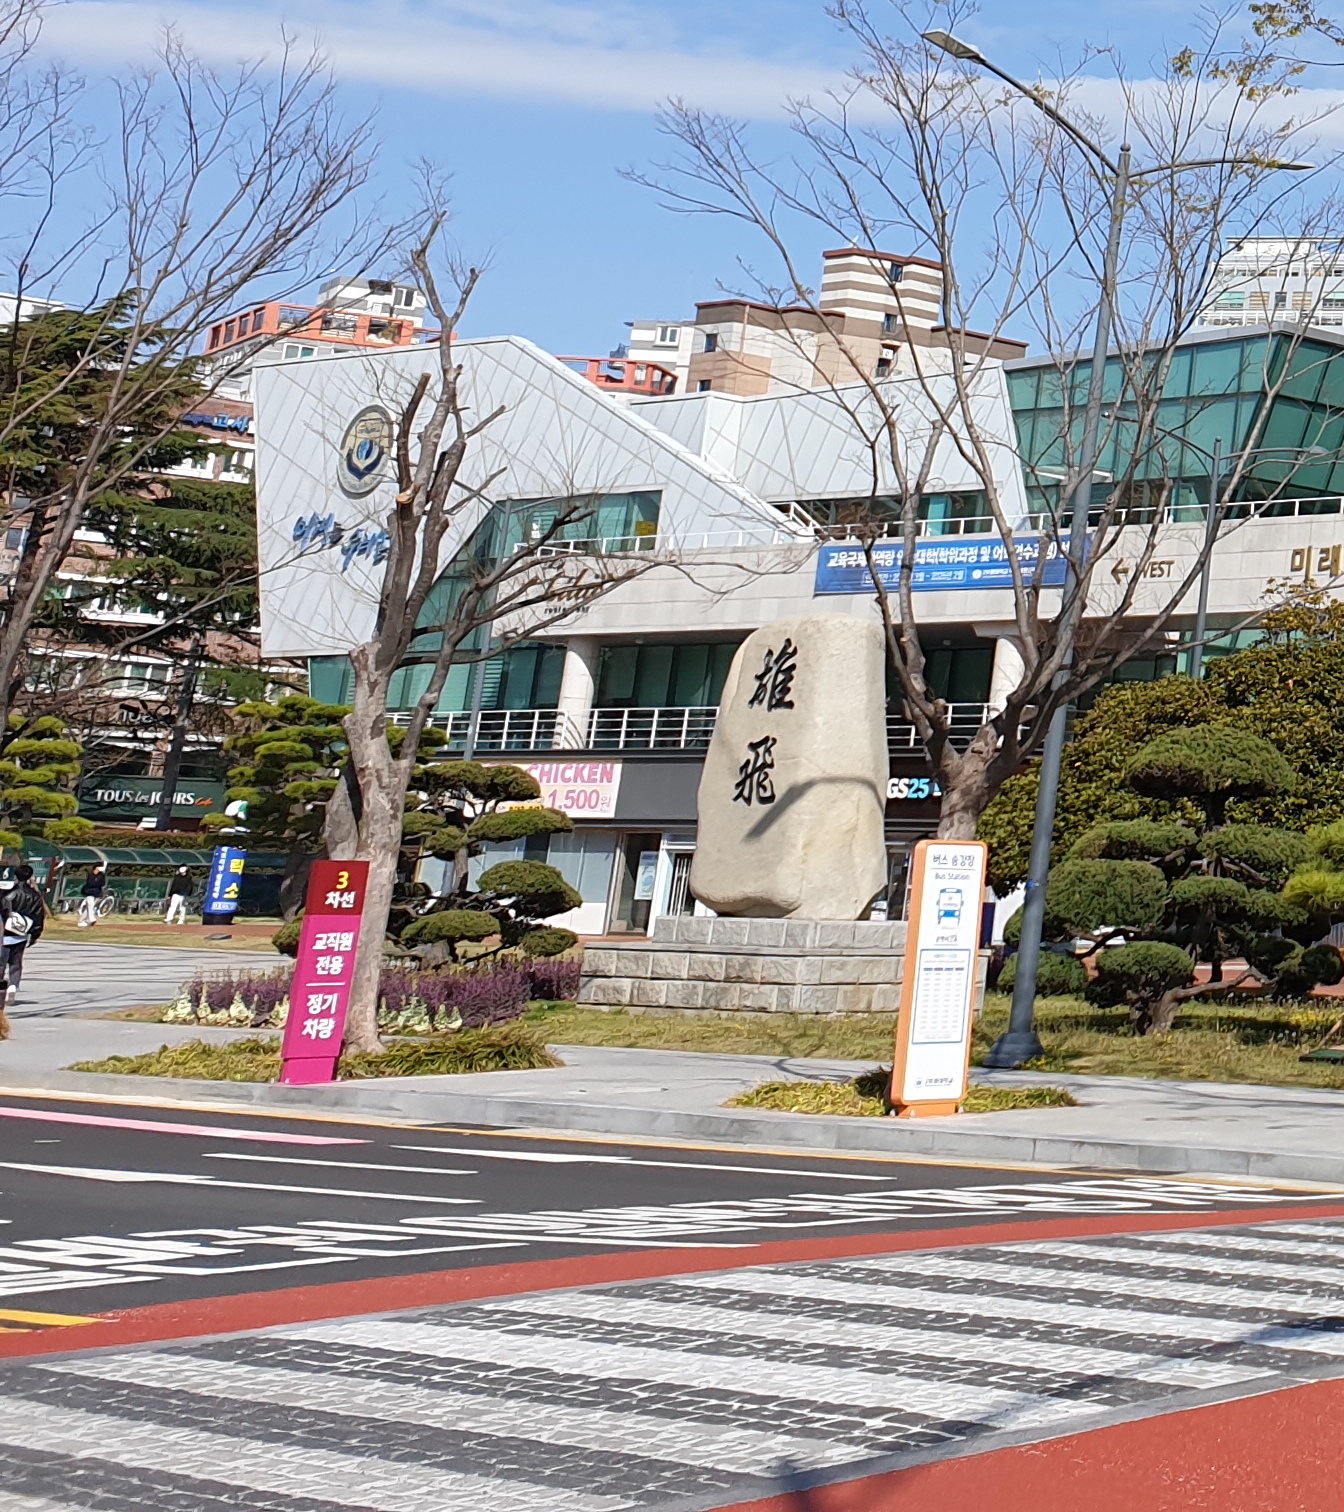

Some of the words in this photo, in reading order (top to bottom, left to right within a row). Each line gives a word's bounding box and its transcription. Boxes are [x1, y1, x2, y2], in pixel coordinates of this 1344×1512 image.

[897, 546, 979, 566] 인대학(학위과정
[980, 545, 991, 563] 및
[95, 789, 134, 803] TOUS
[887, 778, 930, 799] GS25
[933, 854, 948, 865] 버스
[336, 871, 349, 889] 3
[325, 891, 355, 909] 차선
[312, 932, 354, 951] 교직원
[315, 956, 344, 975] 전용
[306, 993, 338, 1015] 정기
[302, 1018, 336, 1040] 차량
